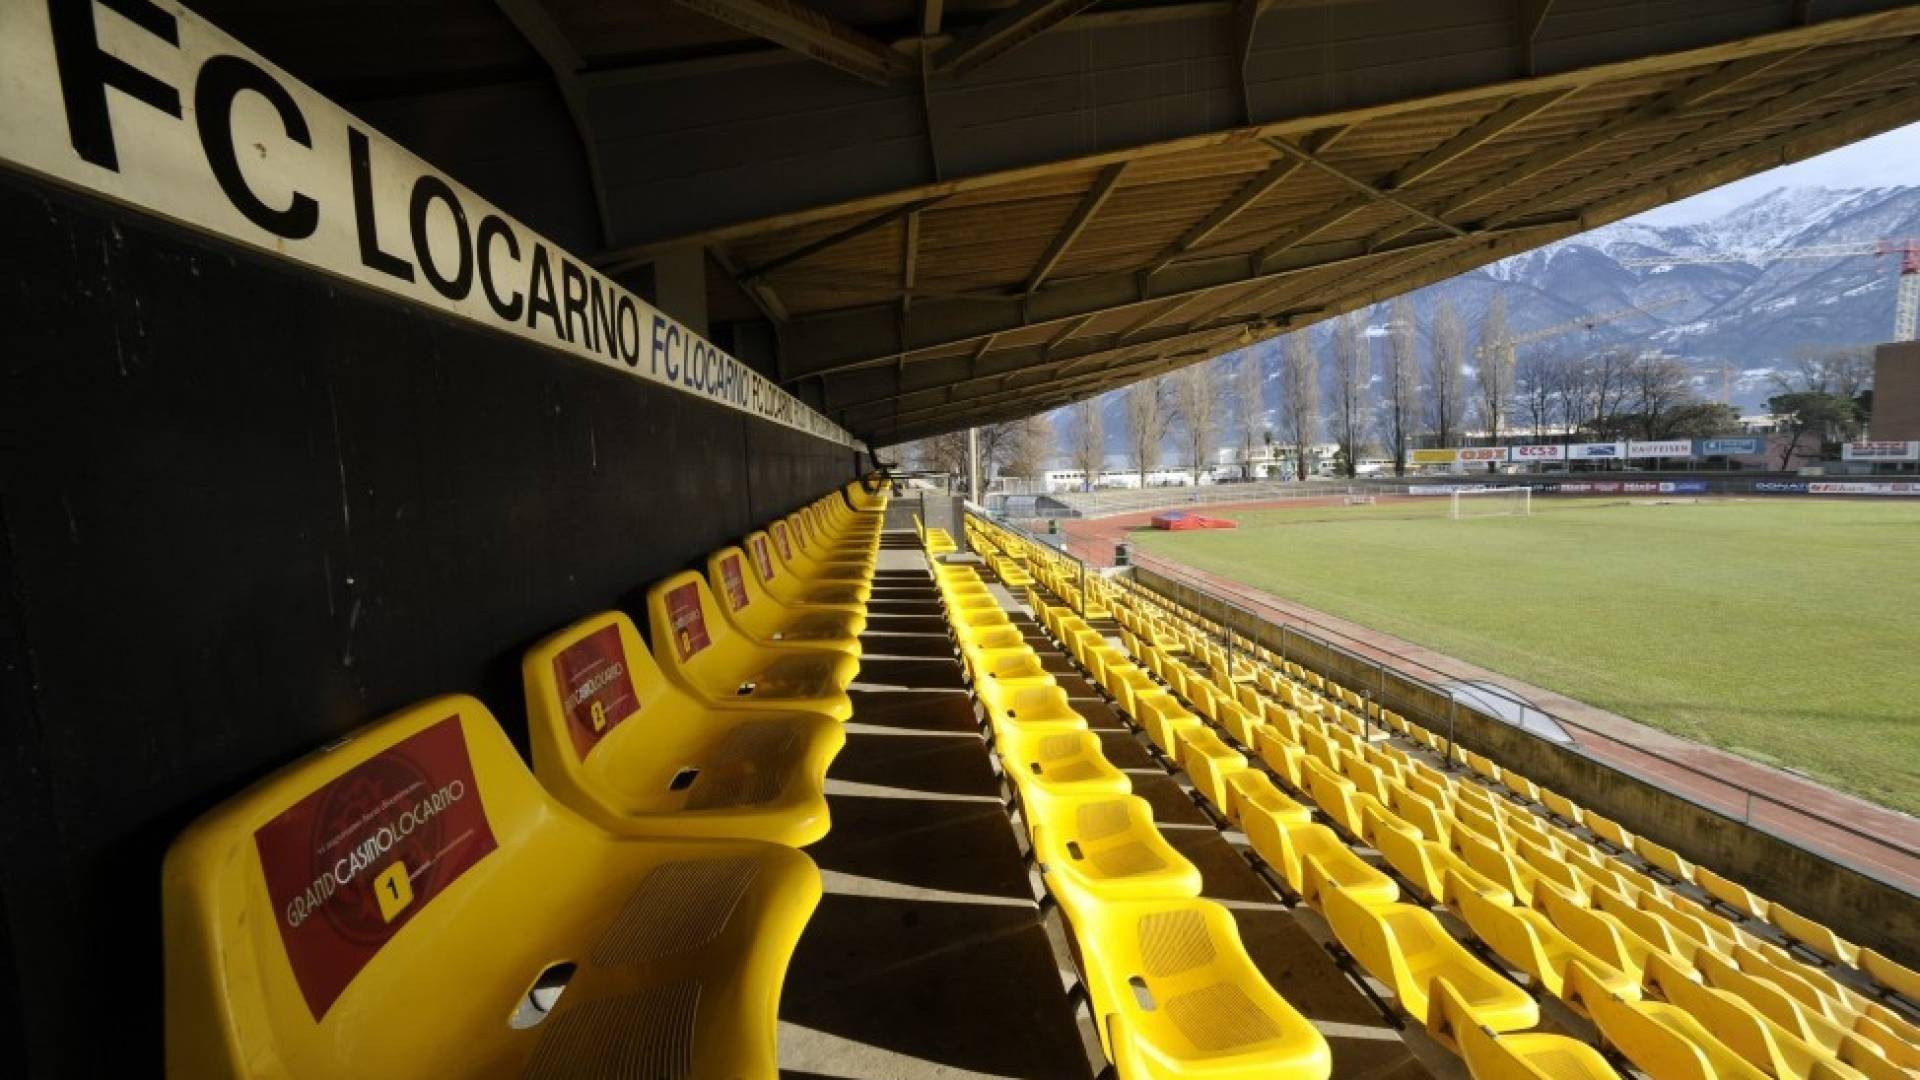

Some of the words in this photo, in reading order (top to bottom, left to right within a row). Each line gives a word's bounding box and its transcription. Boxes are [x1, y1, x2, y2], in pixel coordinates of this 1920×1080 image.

[46, 0, 320, 240] FC
[348, 125, 640, 368] LOCARNO
[652, 314, 680, 381] FC
[683, 332, 750, 407] LOCARNO
[1460, 449, 1507, 460] OBI
[385, 876, 399, 901] 1
